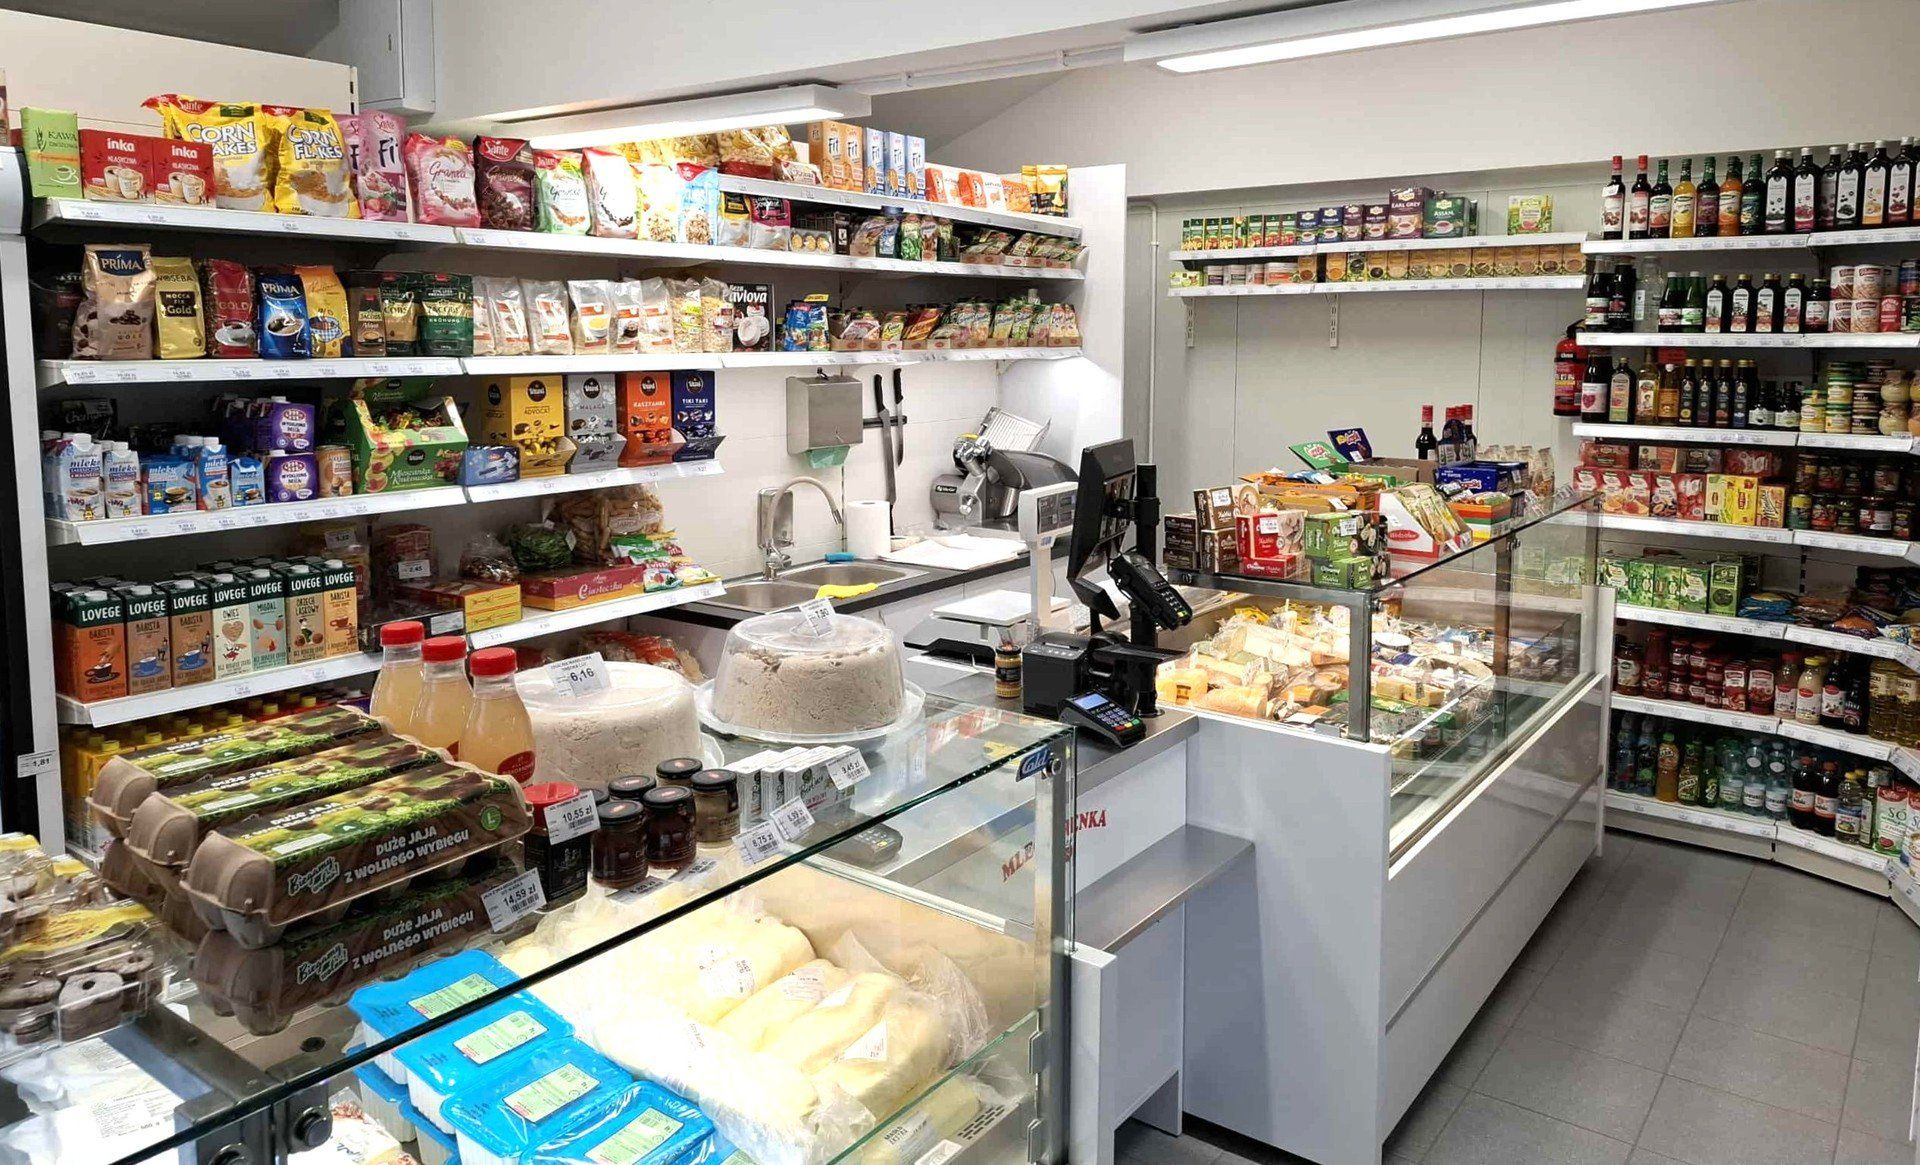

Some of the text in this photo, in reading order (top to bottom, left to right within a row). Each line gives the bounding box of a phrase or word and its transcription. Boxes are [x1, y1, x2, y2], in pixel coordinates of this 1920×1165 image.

[186, 121, 257, 142] CORN
[288, 123, 339, 148] CORN
[106, 137, 136, 153] inka
[171, 145, 198, 160] inka
[211, 141, 258, 157] AKES
[379, 137, 400, 168] Fi
[729, 290, 768, 304] avlova
[291, 576, 321, 592] LOVEGE
[325, 570, 354, 586] LOVEGE
[214, 587, 246, 603] LOVEGE
[250, 581, 283, 597] LOVEGE
[129, 599, 166, 616] LOVEGE
[173, 594, 208, 610] LOVEGE
[81, 605, 121, 622] LOVEGE
[569, 666, 595, 683] 6,16
[486, 812, 496, 825] L
[562, 807, 584, 823] 10,55
[407, 824, 438, 845] JAJA
[343, 869, 354, 884] Z
[502, 887, 527, 907] 14,59
[414, 907, 444, 928] JAJA
[352, 956, 363, 970] Z
